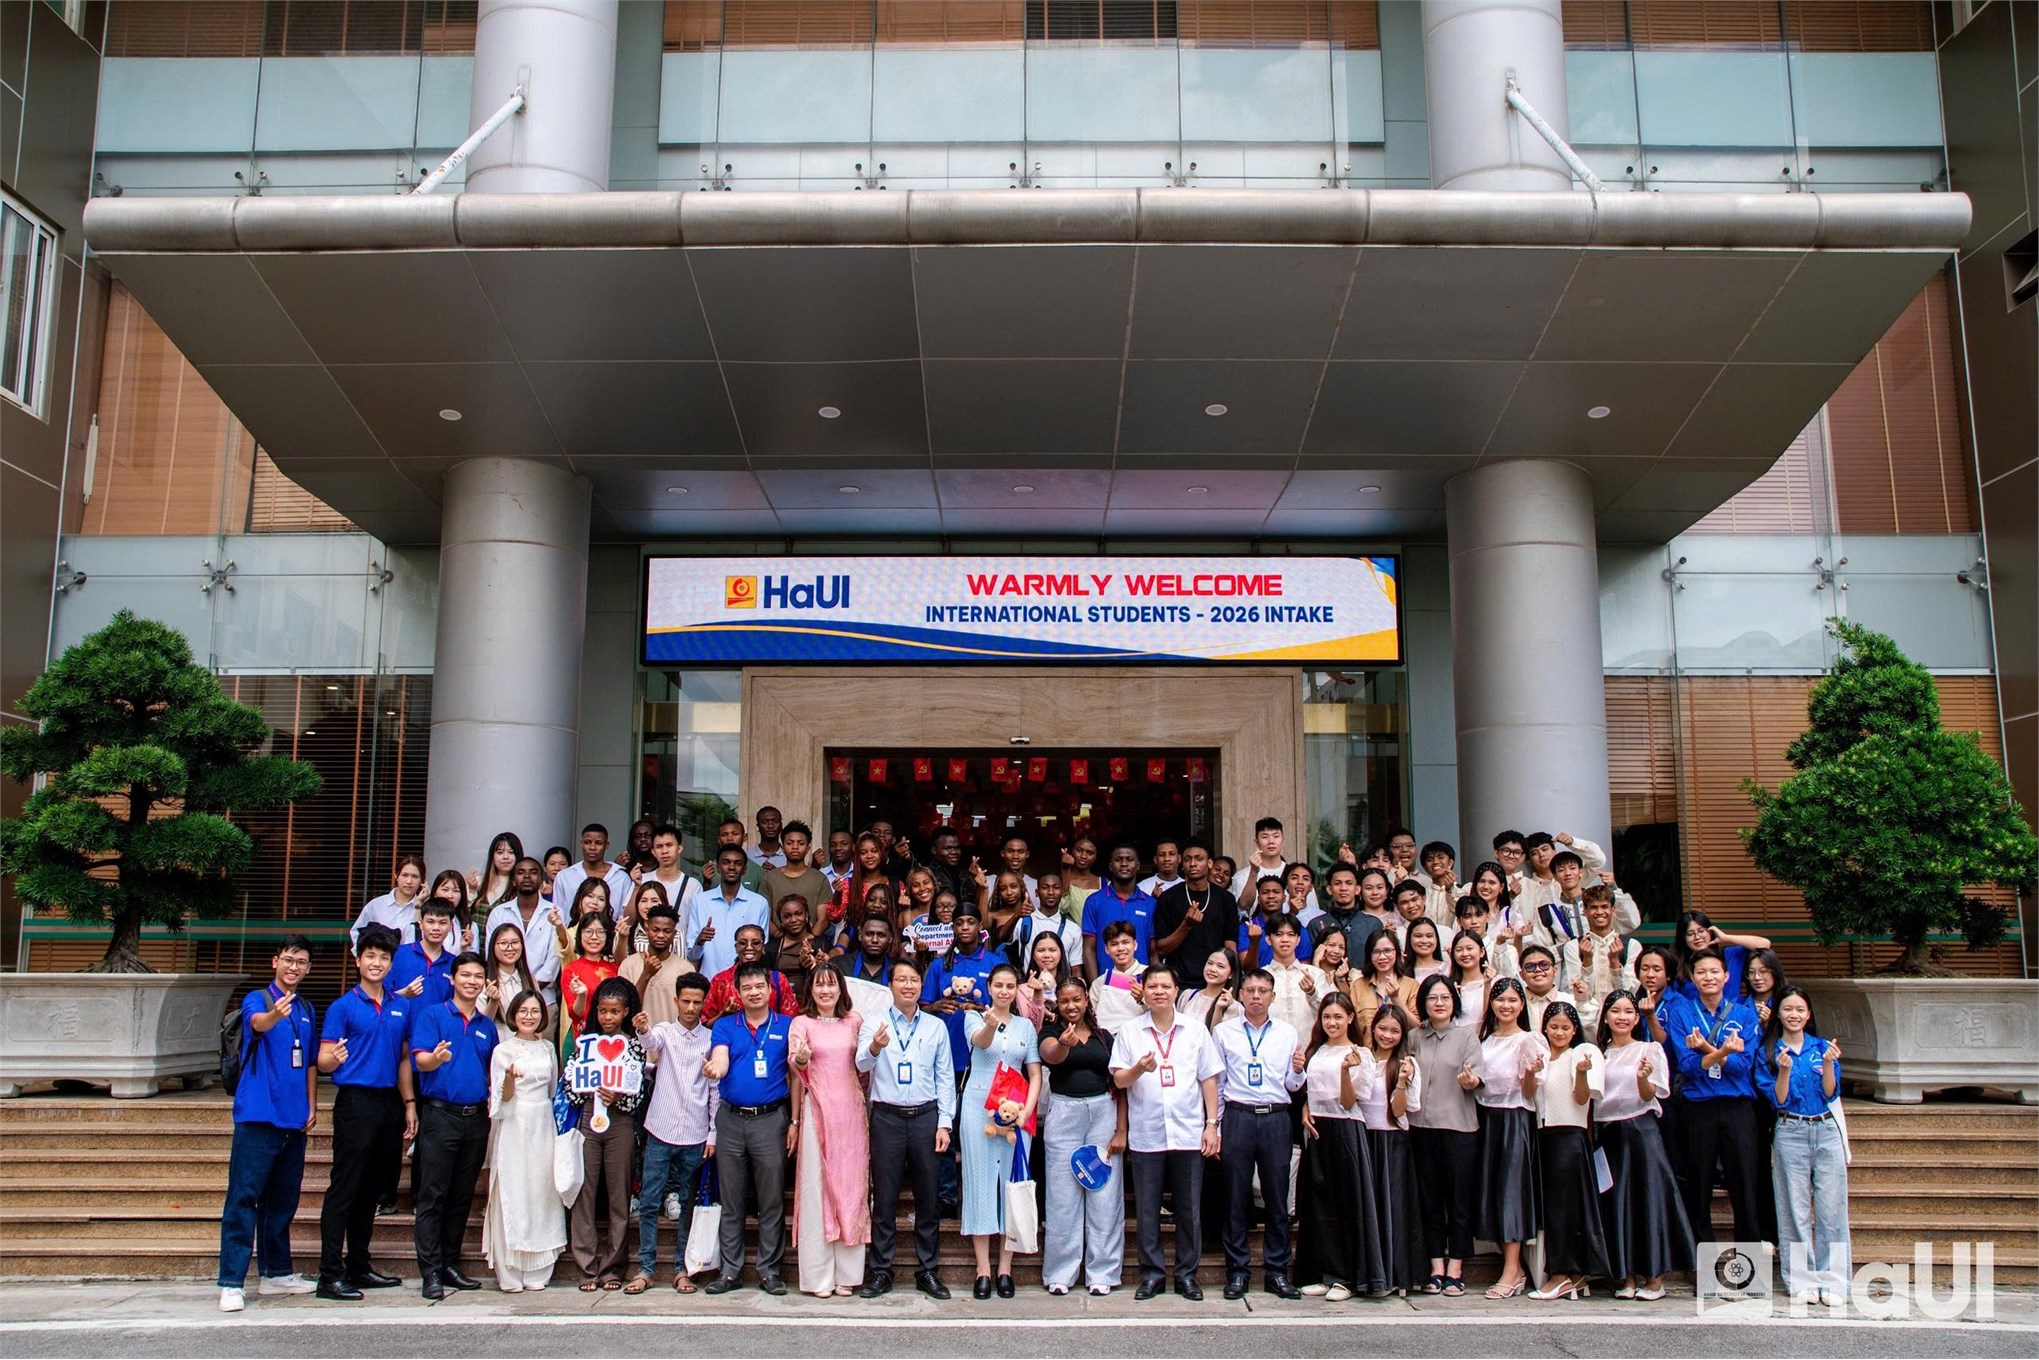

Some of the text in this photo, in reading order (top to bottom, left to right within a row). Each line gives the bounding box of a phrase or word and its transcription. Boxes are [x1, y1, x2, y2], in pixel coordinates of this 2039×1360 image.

[763, 575, 850, 609] HaUI
[967, 574, 1283, 596] WARMLY WELCOME
[926, 605, 1083, 623] INTERNATIONAL
[1087, 605, 1191, 623] STUDENTS
[1210, 605, 1260, 623] 2026
[1265, 605, 1334, 623] INTAKE
[914, 924, 943, 933] Connect
[918, 932, 954, 940] Departmen
[579, 1037, 597, 1064] I
[575, 1065, 623, 1089] HaUI
